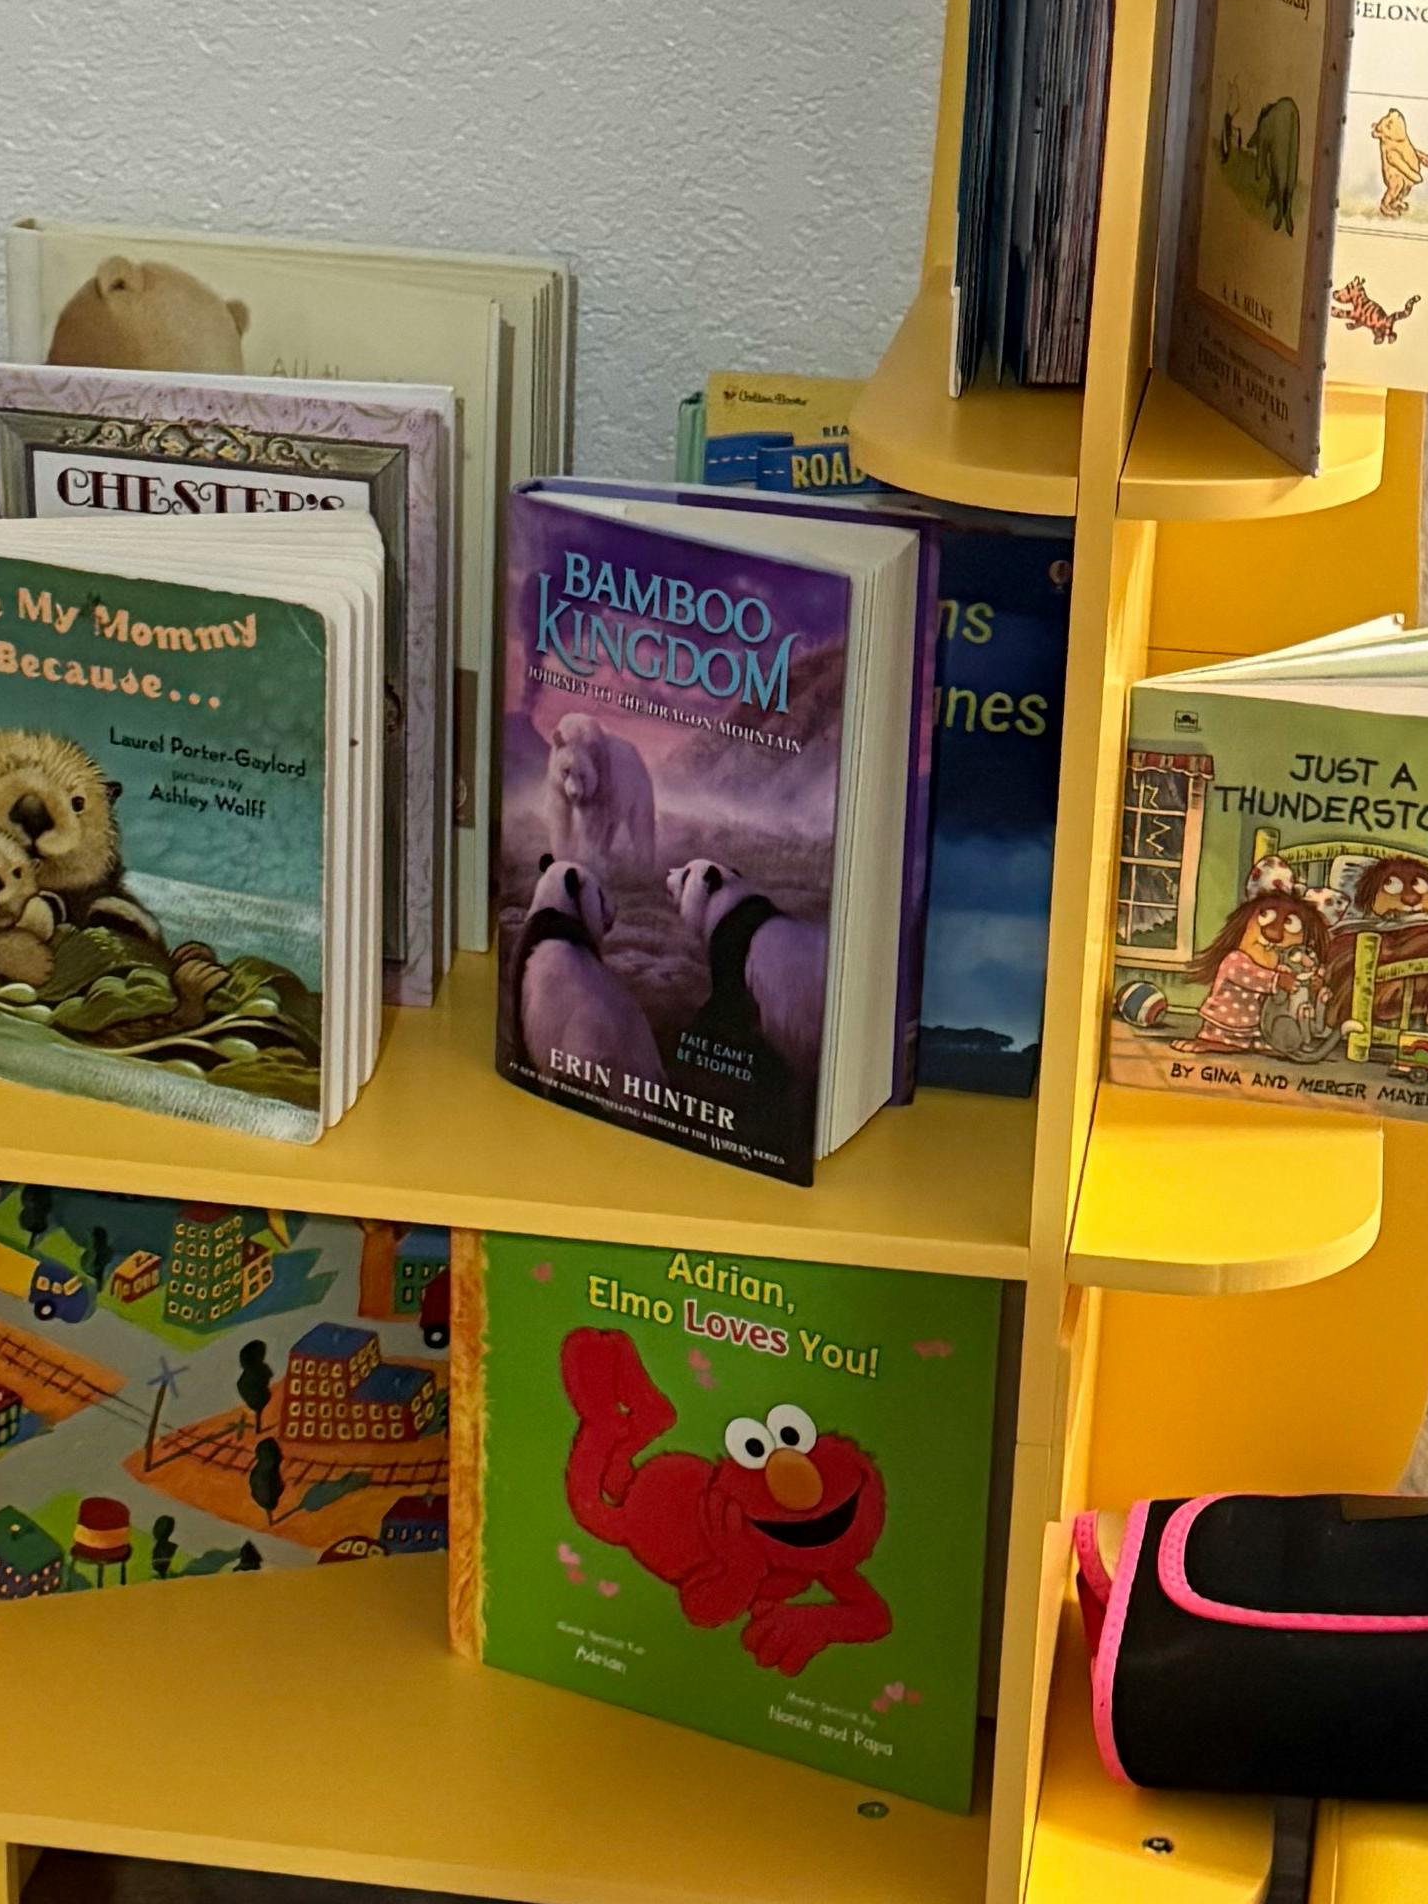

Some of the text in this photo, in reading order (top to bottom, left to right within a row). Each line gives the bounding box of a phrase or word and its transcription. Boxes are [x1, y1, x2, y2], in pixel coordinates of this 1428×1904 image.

[17, 586, 80, 634] My
[92, 604, 258, 652] Mommy
[563, 550, 772, 643] BAMBOO
[536, 573, 800, 714] KINGDOM
[528, 665, 802, 754] JOURNEY TO THE DRAGON MOUNTAIN
[110, 725, 307, 777] Laurel Porter-Gaylord
[1289, 753, 1418, 792] JUST A
[148, 783, 267, 820] Ashley Wolff
[550, 1048, 735, 1131] ERIN HUNTER
[1170, 1062, 1195, 1079] BY
[1200, 1065, 1242, 1085] GINA
[1251, 1072, 1289, 1090] AND
[1296, 1076, 1368, 1100] MERCER
[668, 1253, 795, 1315] Adrian,
[588, 1275, 879, 1379] Elmo Loves You!
